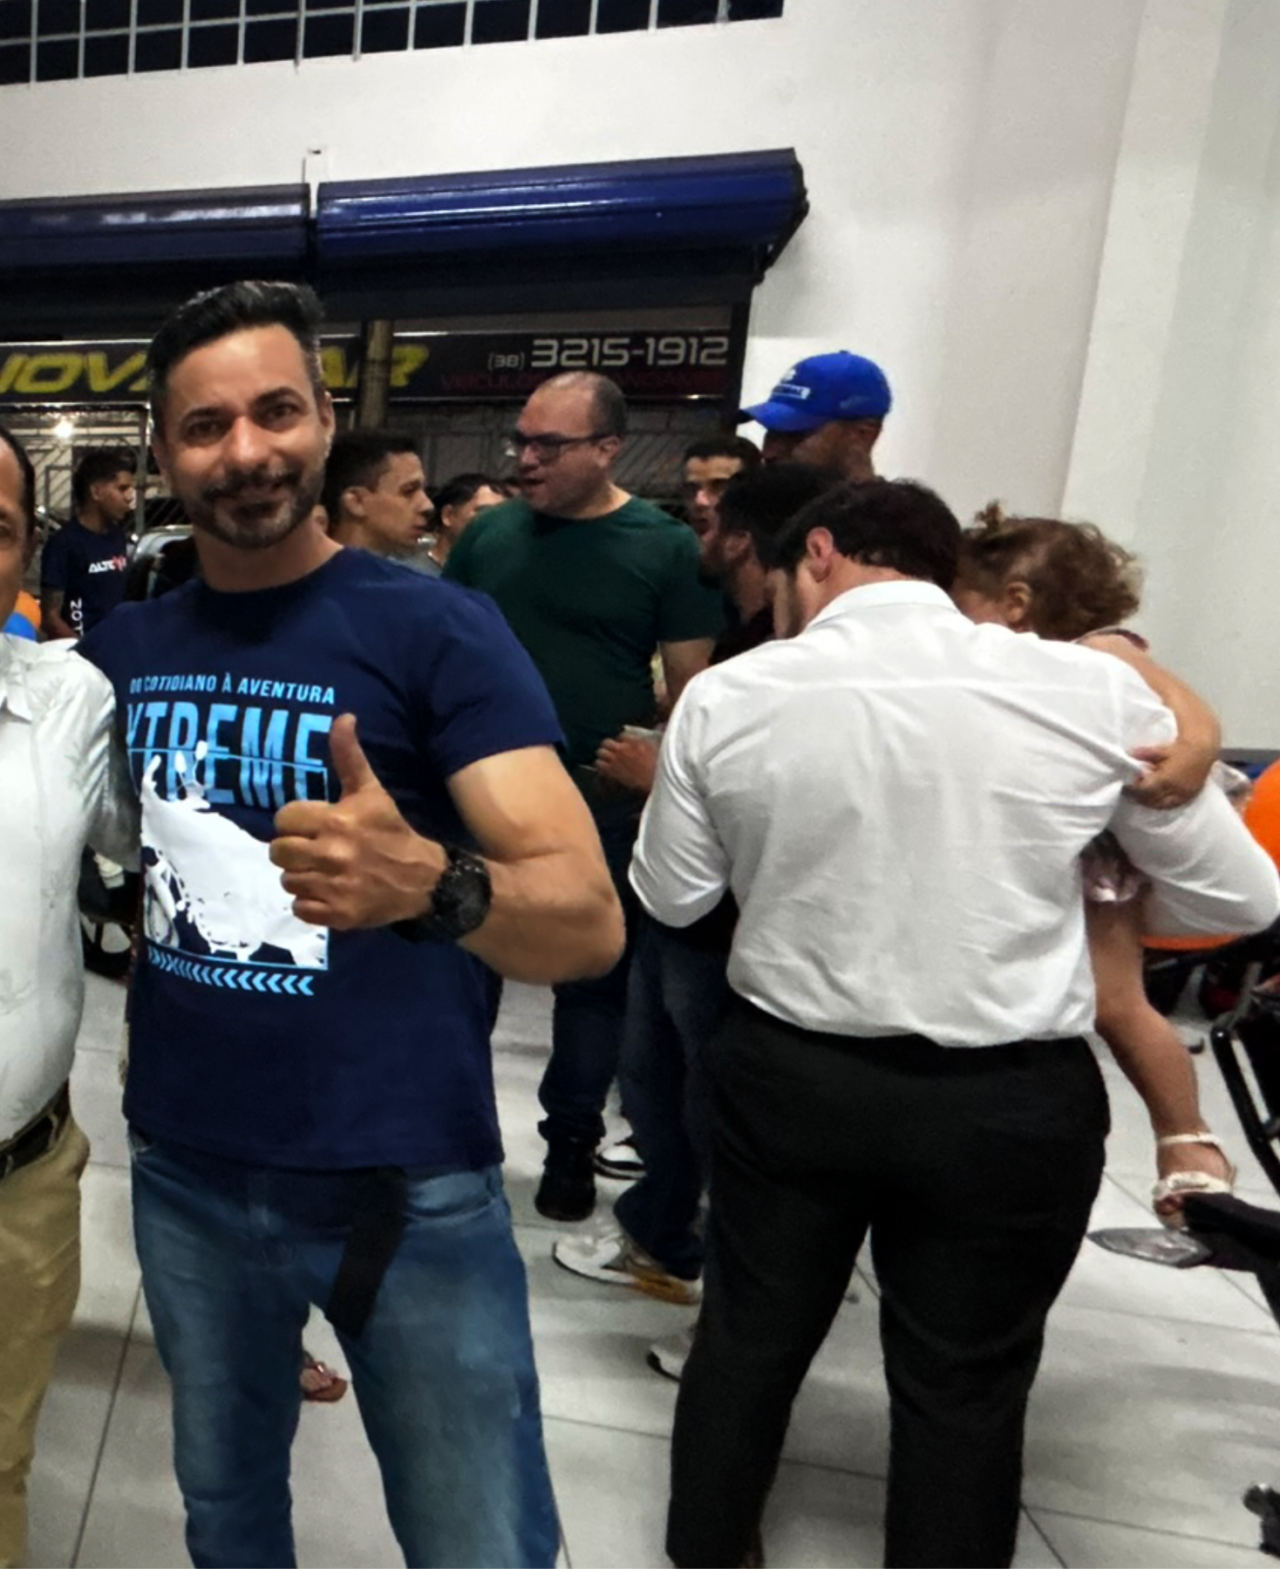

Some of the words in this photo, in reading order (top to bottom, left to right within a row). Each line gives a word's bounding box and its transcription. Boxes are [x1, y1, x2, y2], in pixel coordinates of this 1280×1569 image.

[487, 351, 524, 370] (38)
[531, 336, 728, 368] 3215-1912
[144, 674, 218, 693] COTIDIANO
[221, 672, 233, 693] À
[237, 677, 335, 704] AVENTURA
